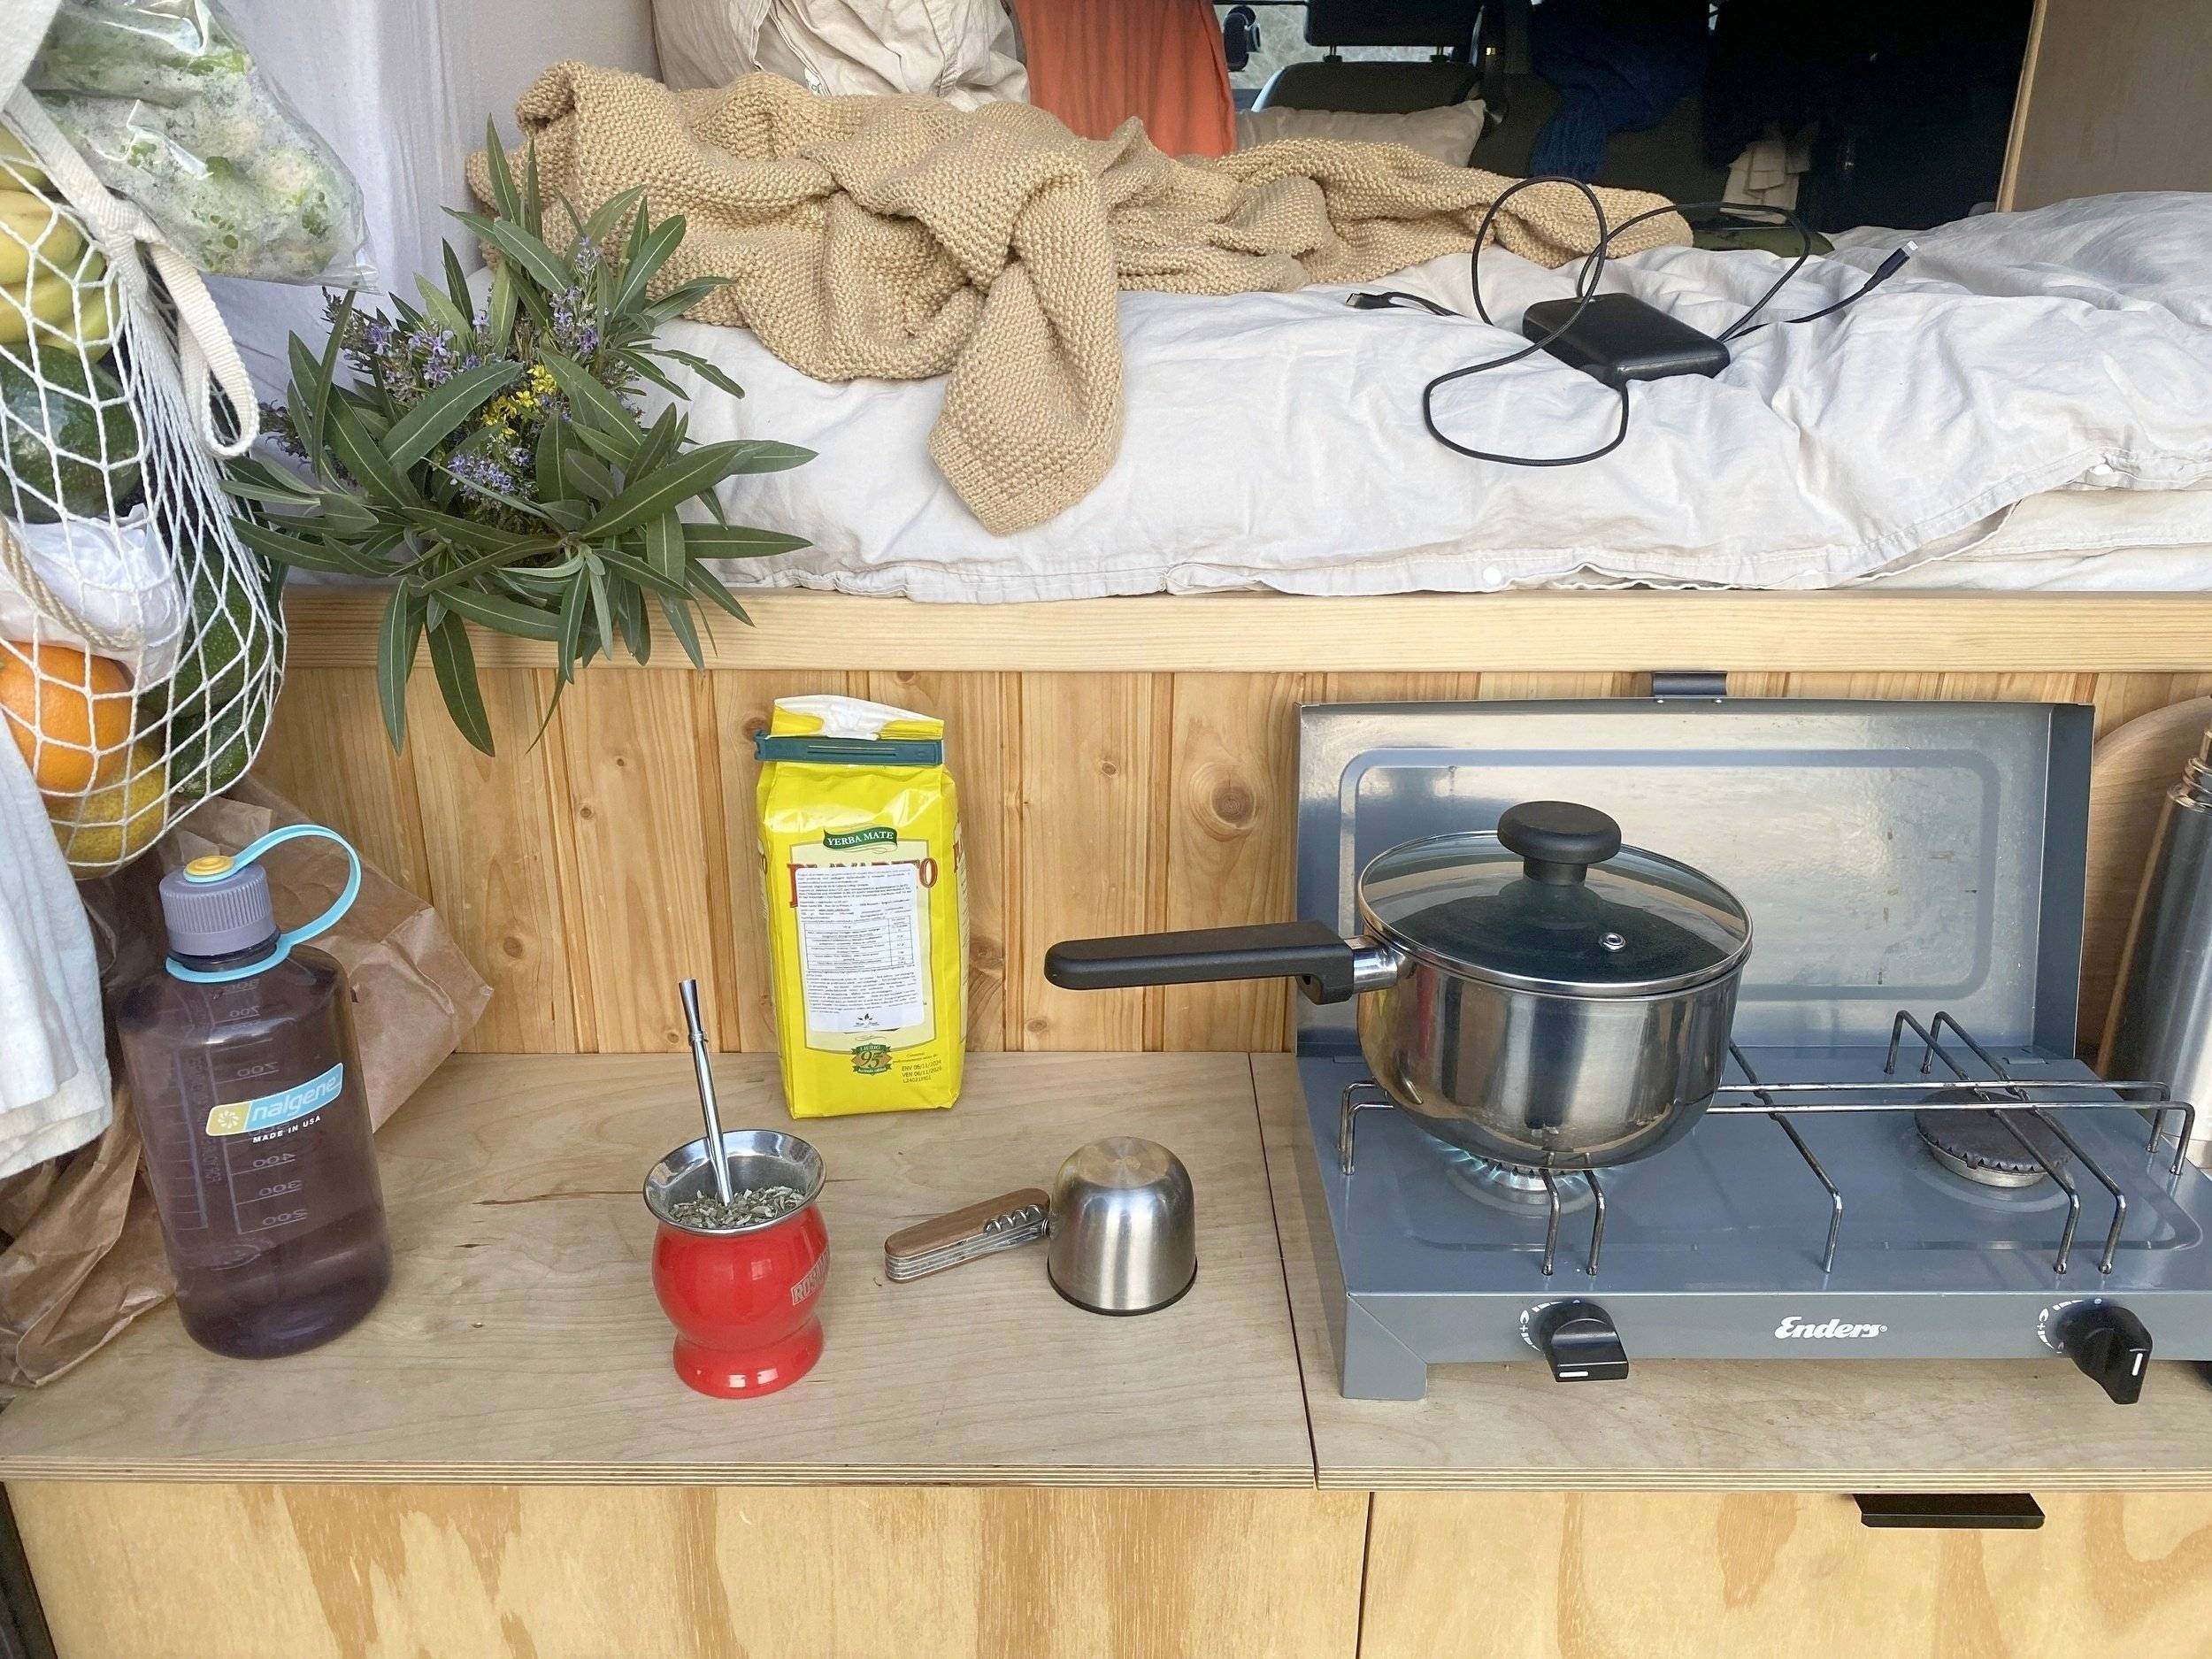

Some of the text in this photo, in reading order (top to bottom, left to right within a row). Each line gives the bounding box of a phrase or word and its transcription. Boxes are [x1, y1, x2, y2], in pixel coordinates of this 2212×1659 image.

[827, 831, 894, 846] YERBA MATE
[860, 1051, 884, 1068] 95
[252, 1076, 336, 1122] nalgene
[252, 1115, 321, 1143] MADE IN USA
